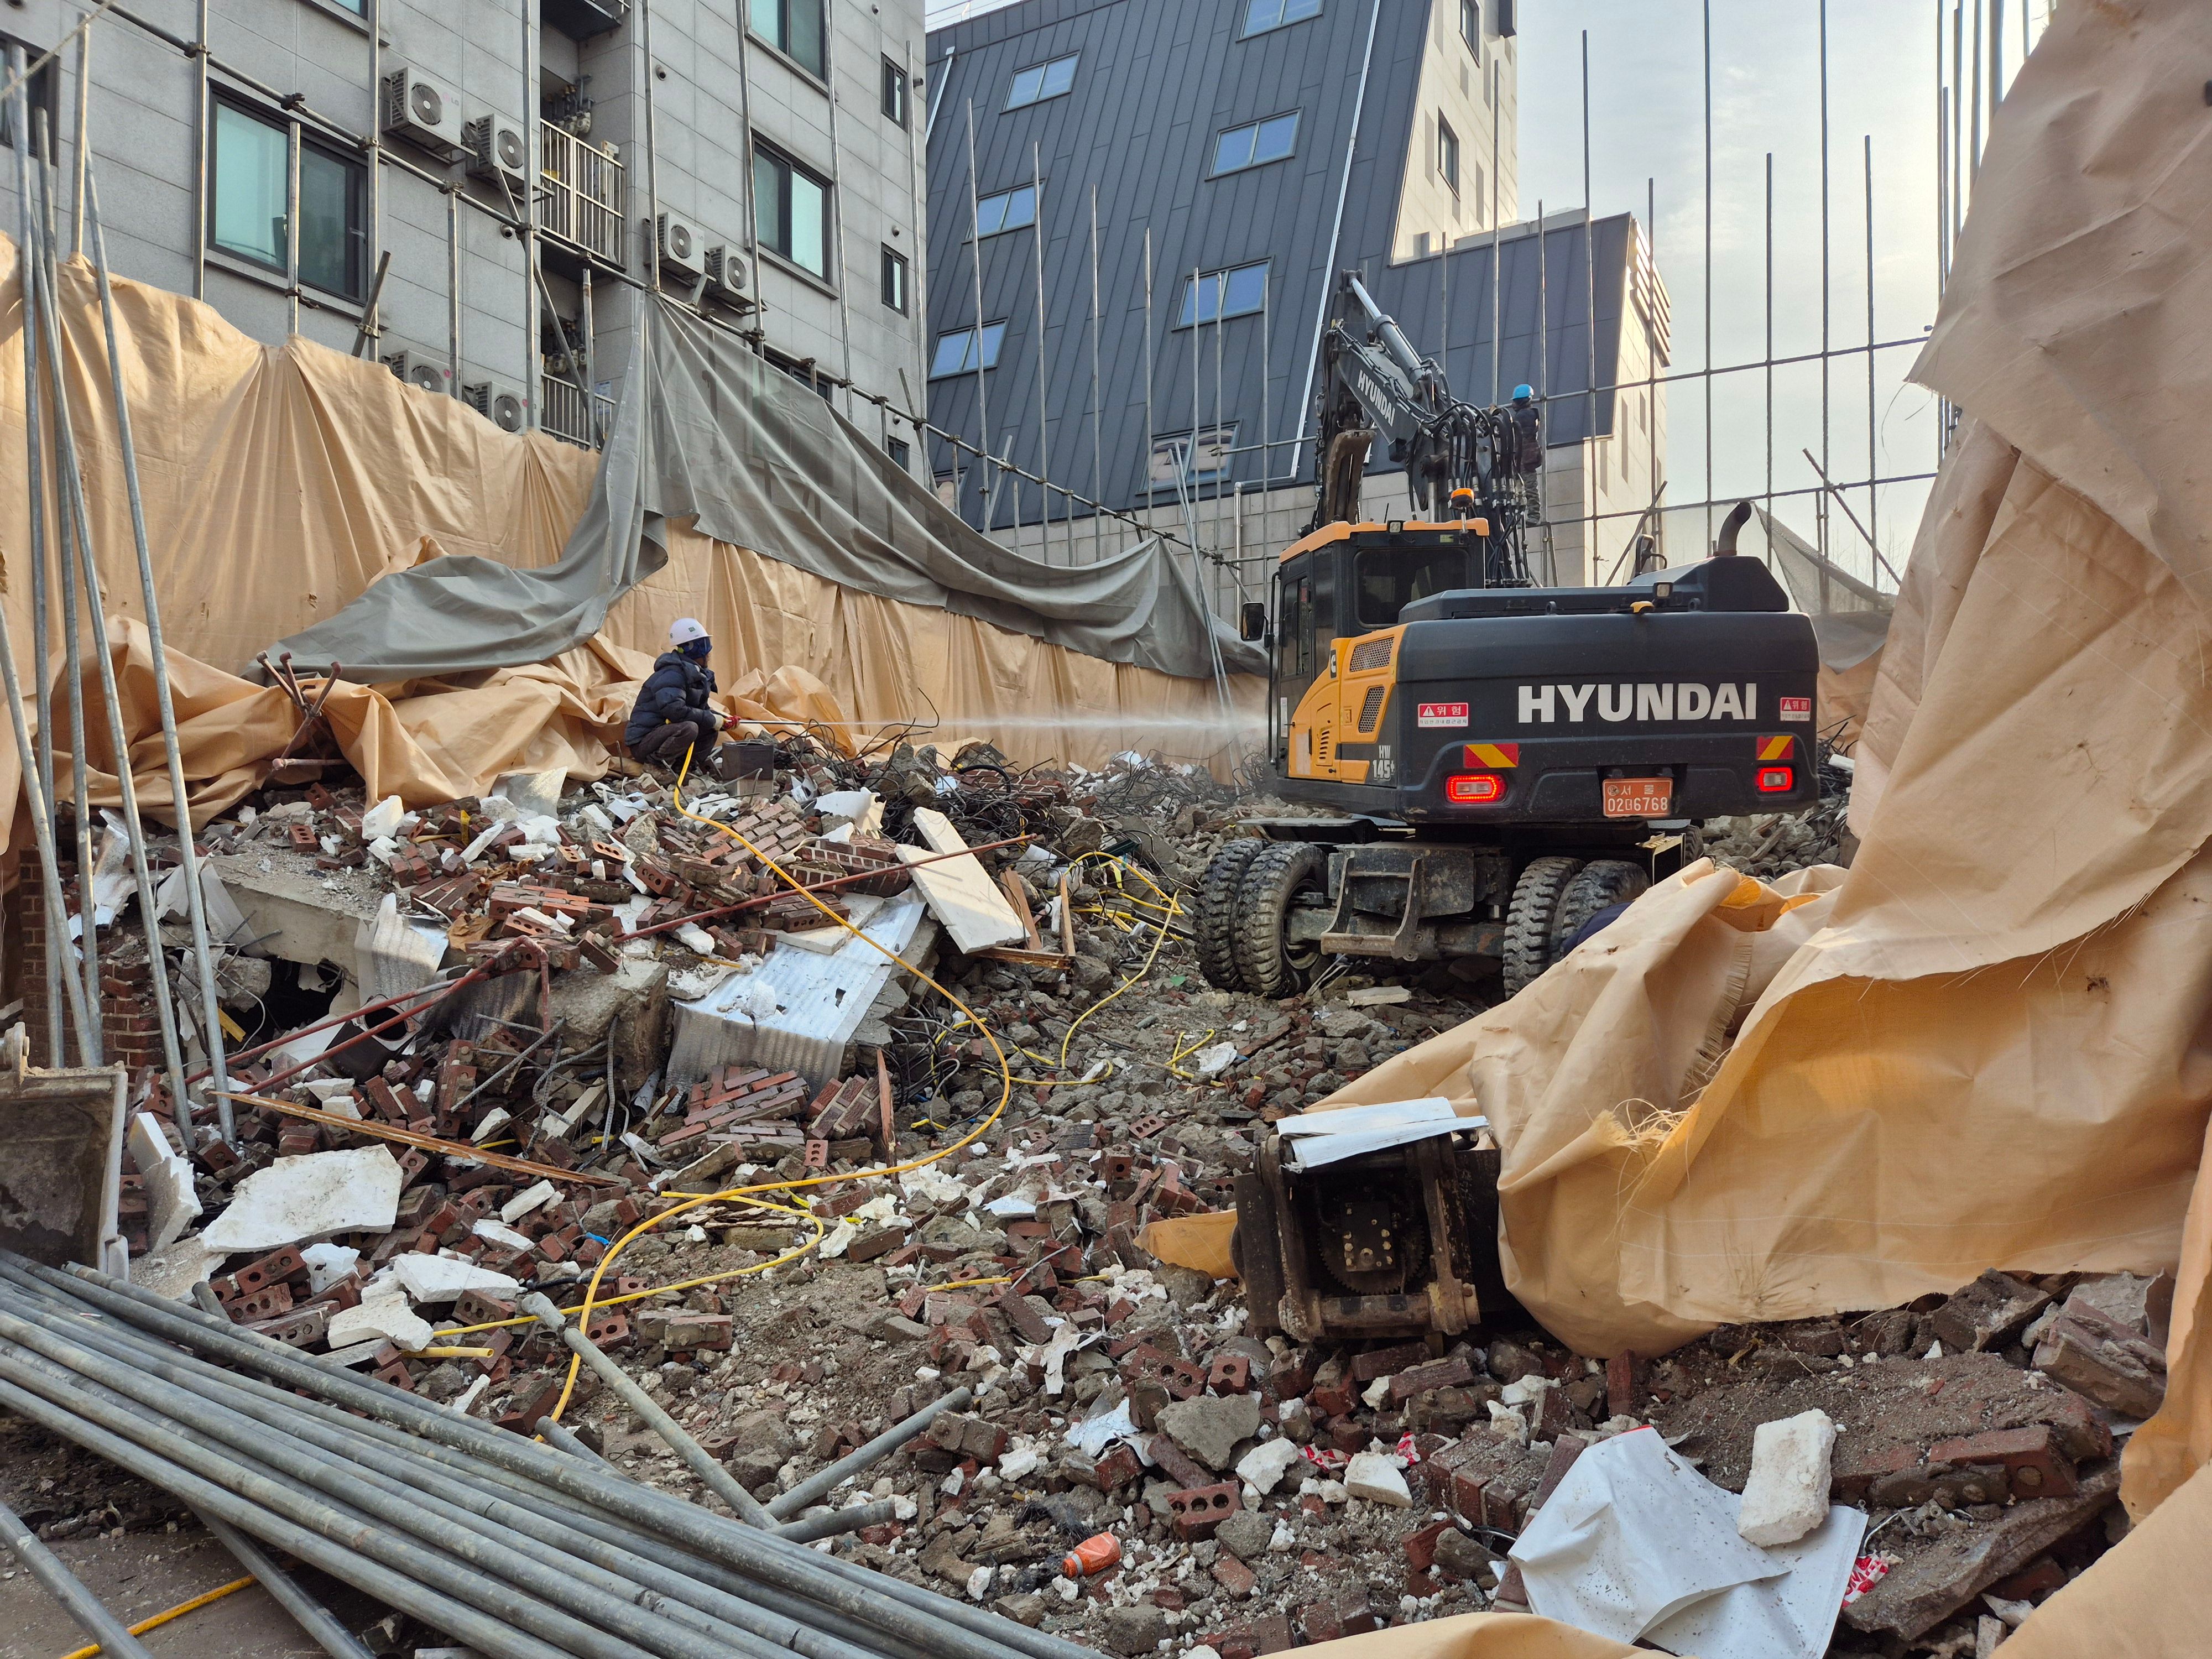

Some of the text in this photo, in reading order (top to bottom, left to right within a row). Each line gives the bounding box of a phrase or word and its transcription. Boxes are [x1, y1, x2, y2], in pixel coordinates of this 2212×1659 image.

[1358, 369, 1396, 427] HYUNDAI
[1518, 683, 1757, 723] HYUNDAI
[1379, 745, 1391, 759] HW
[1608, 797, 1668, 812] 02더6768
